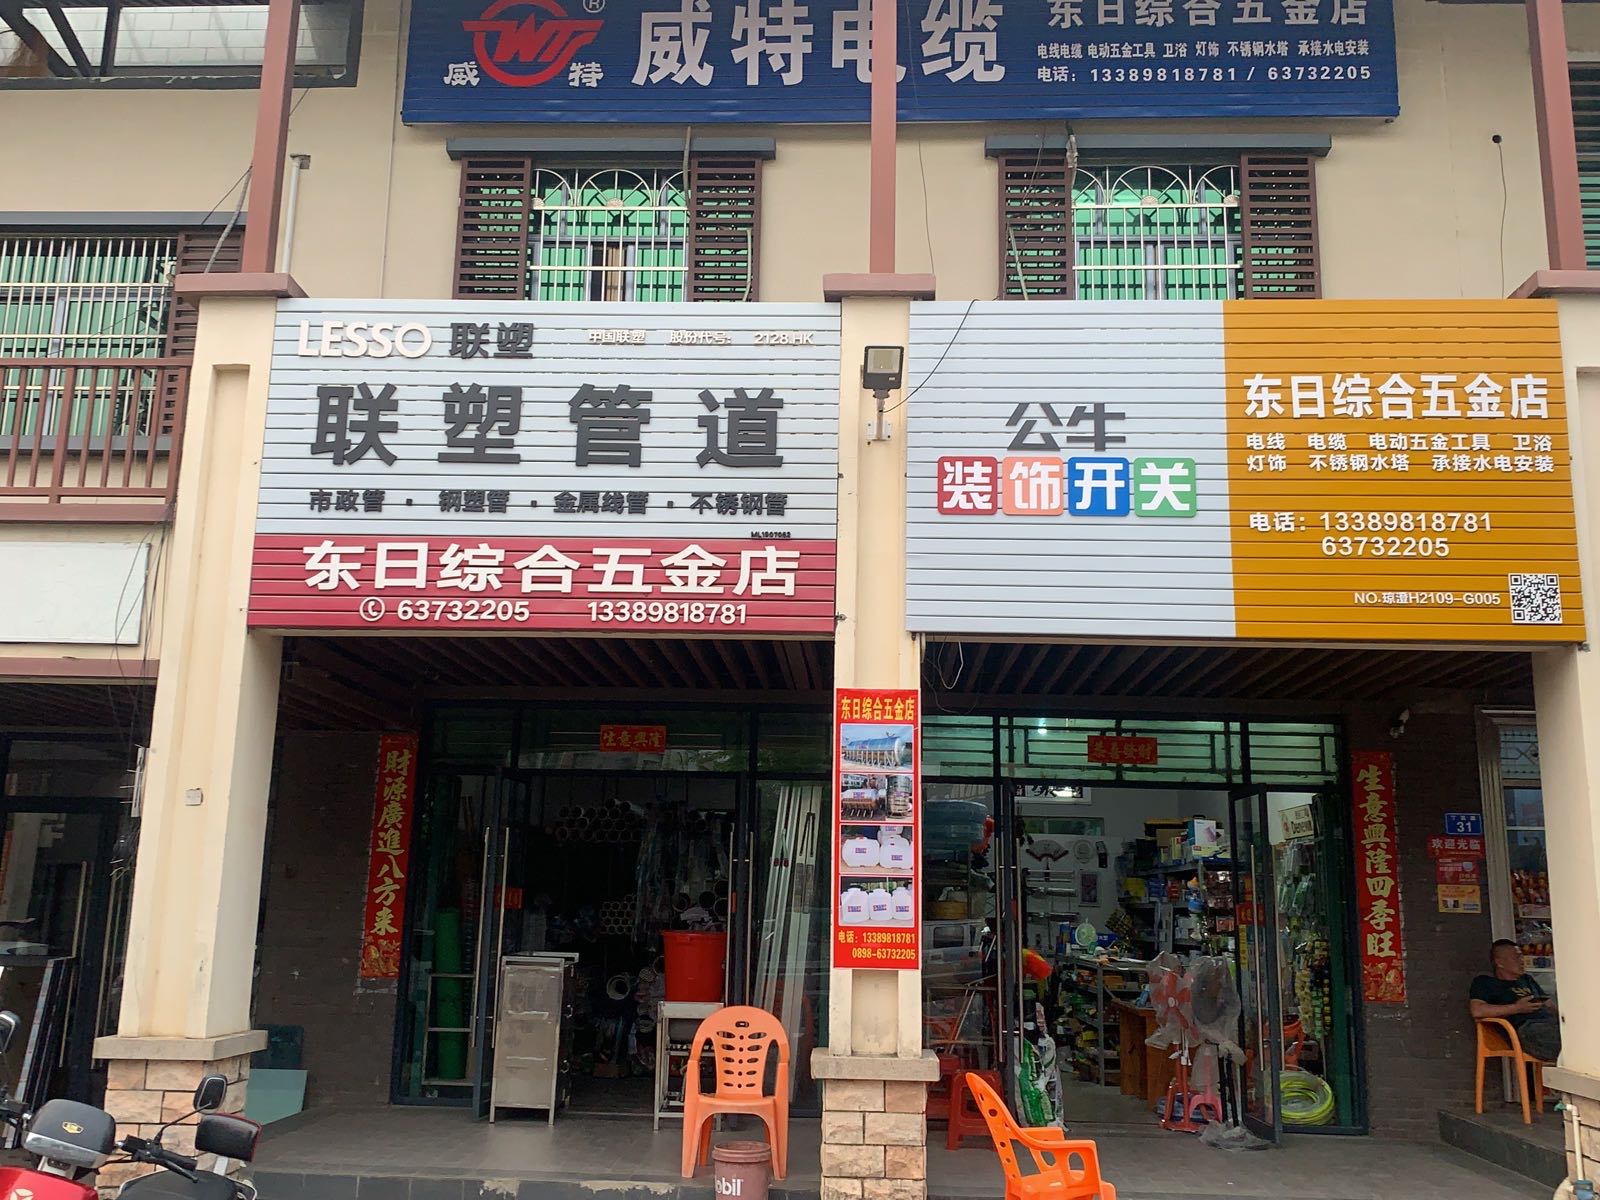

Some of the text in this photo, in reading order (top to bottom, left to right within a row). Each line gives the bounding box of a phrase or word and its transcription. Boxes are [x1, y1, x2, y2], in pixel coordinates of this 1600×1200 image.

[631, 0, 1005, 86] 威特电缆
[1037, 39, 1369, 59] 电线电缆 电动五金工具 卫浴 灯饰 不锈钢水塔 承接水电安装
[1090, 67, 1237, 82] 13389818781
[1267, 65, 1371, 81] 63732205
[298, 320, 535, 359] LESSO 联塑
[588, 330, 646, 344] 中国联塑
[754, 331, 814, 345] 2128.HK
[1243, 373, 1549, 420] 东日综合五金店
[310, 381, 784, 468] 联塑管道
[1004, 402, 1126, 452] 公牛
[1246, 433, 1553, 452] 电线 电缆 电动五金工具 卫浴
[1247, 454, 1555, 473] 灯饰 不锈钢水塔 承接水电安装
[942, 459, 1192, 513] 装饰开关
[310, 490, 788, 516] 市政管 钢塑管 金属线管 不锈钢管
[1319, 511, 1492, 533] 13389818781
[1321, 536, 1451, 557] 63732205
[302, 540, 800, 597] 东日综合五金店
[397, 600, 747, 625] 63732205 13389818781
[841, 696, 915, 721] 东日综合五金店
[1456, 821, 1473, 832] 31
[862, 931, 915, 944] 13389818781
[852, 948, 916, 960] 0898-63732205
